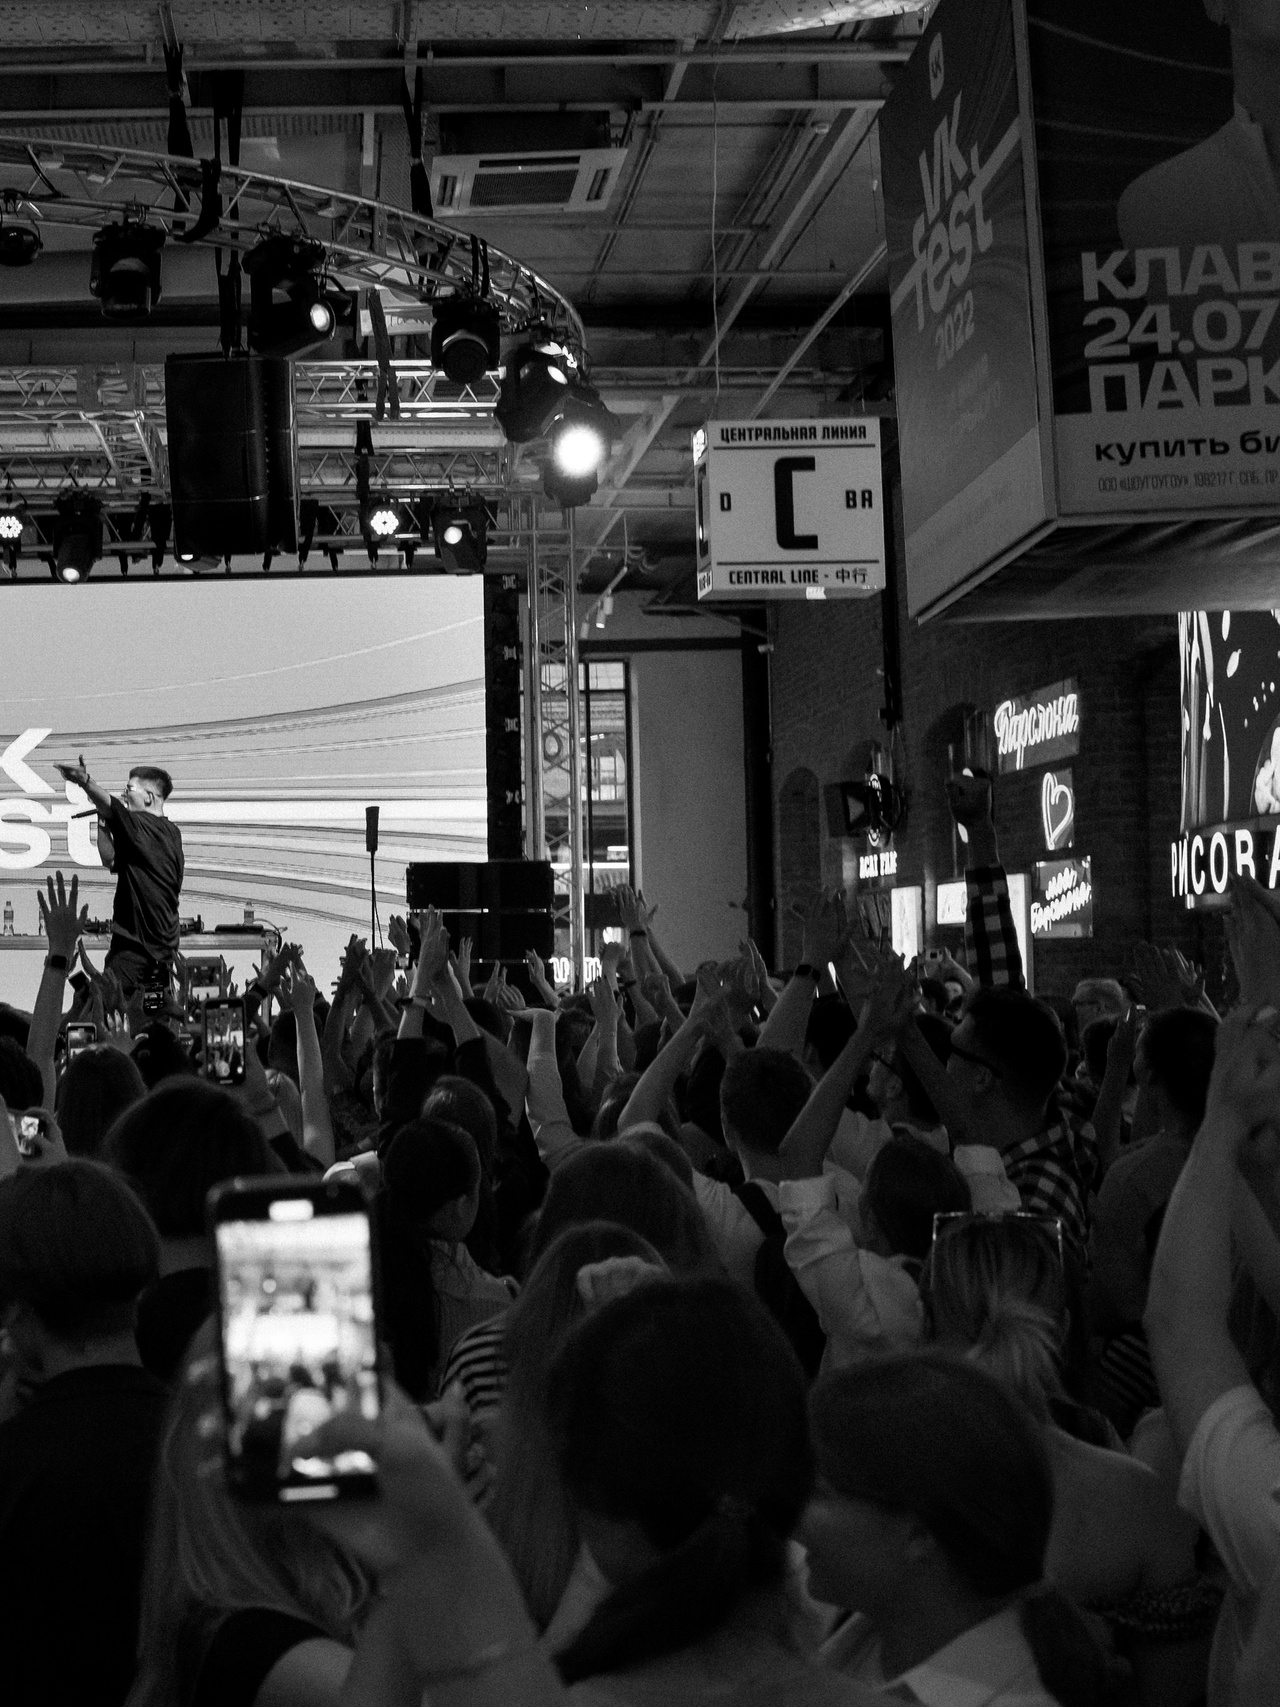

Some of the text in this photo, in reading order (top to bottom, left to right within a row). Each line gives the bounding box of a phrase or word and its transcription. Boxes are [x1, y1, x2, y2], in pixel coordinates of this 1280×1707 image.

[919, 88, 968, 225] VK
[912, 141, 993, 332] fest
[1081, 242, 1280, 301] КЛАВ
[934, 289, 975, 371] 2022
[1082, 299, 1280, 358] 24.07
[1088, 356, 1280, 414] ПАРК
[720, 425, 867, 443] ЦЕНТРАЛЬНАЯ ЛИНИЯ
[1095, 430, 1280, 466] купить би
[774, 456, 819, 550] C
[729, 570, 786, 585] CENTRAL
[790, 569, 819, 583] LINE
